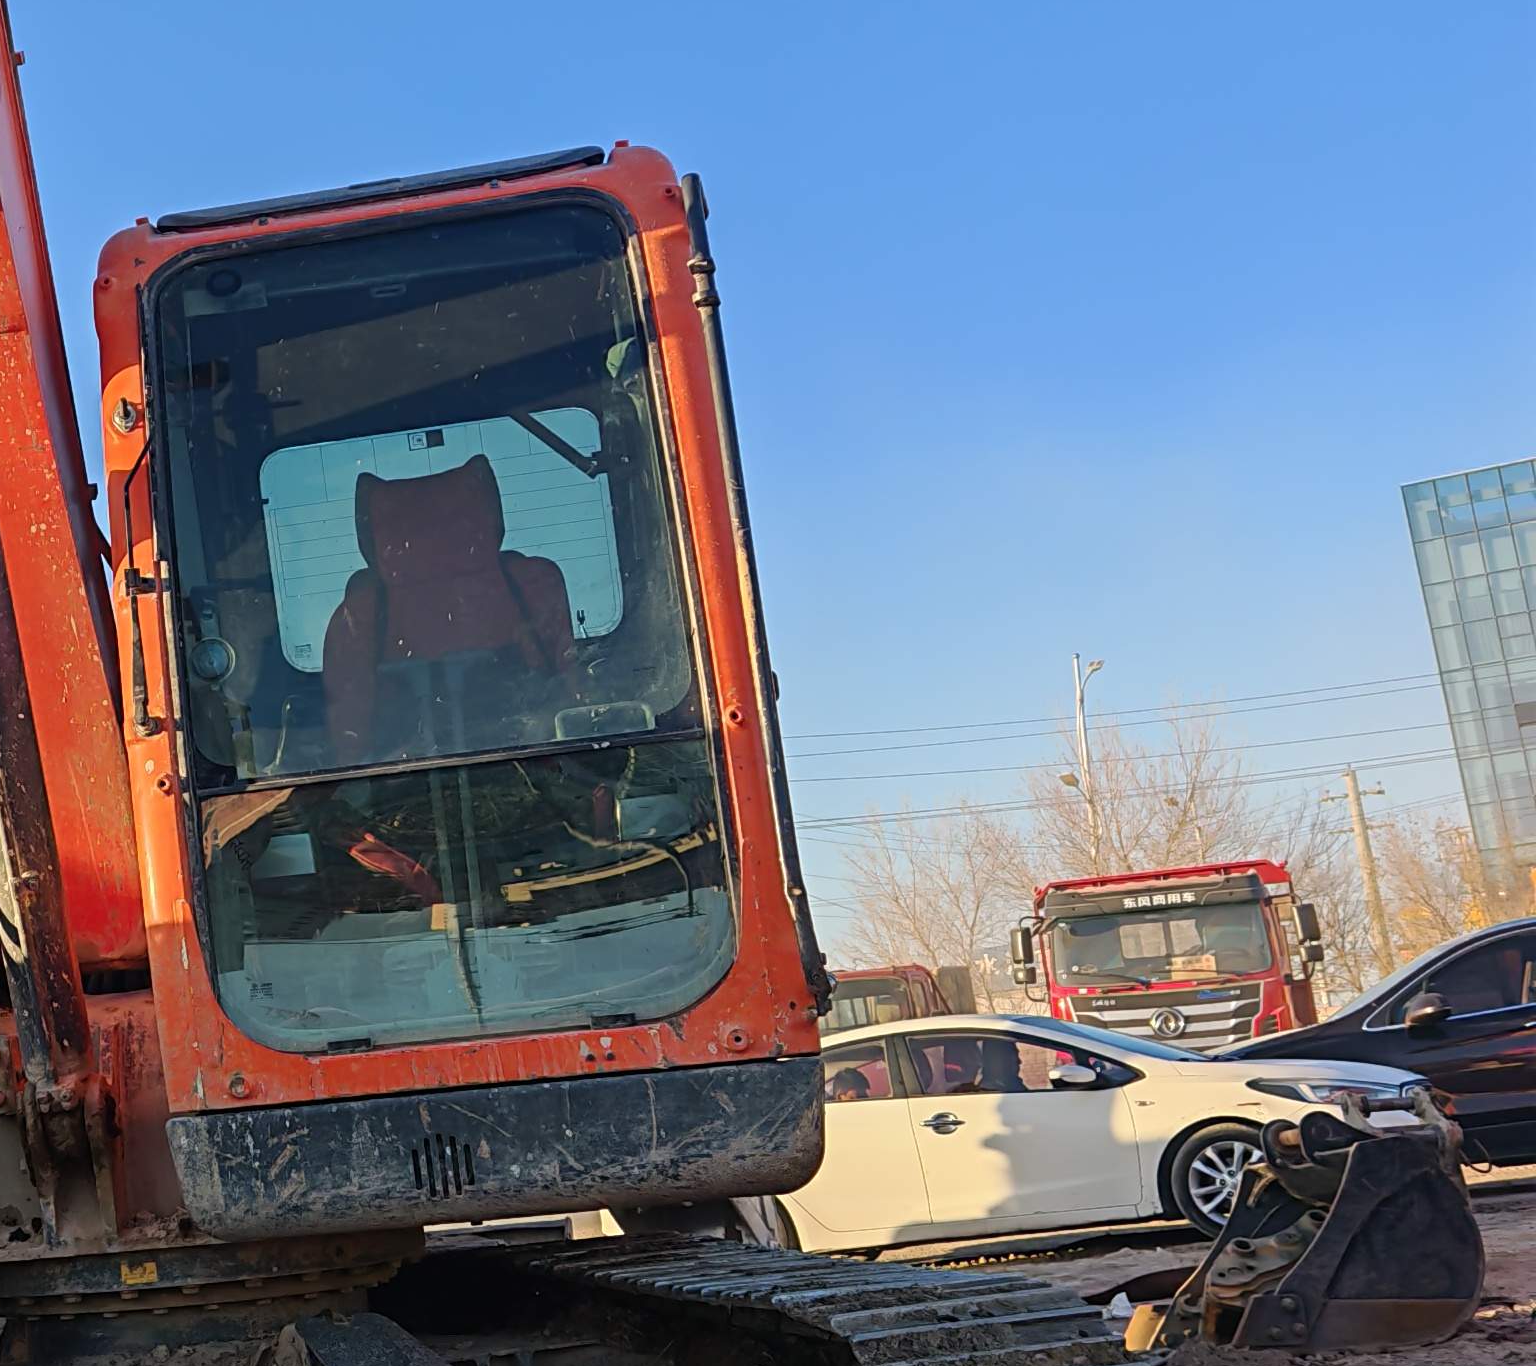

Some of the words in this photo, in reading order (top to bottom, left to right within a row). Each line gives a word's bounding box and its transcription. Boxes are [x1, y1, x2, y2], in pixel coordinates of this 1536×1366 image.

[1122, 892, 1196, 909] 东风商用车
